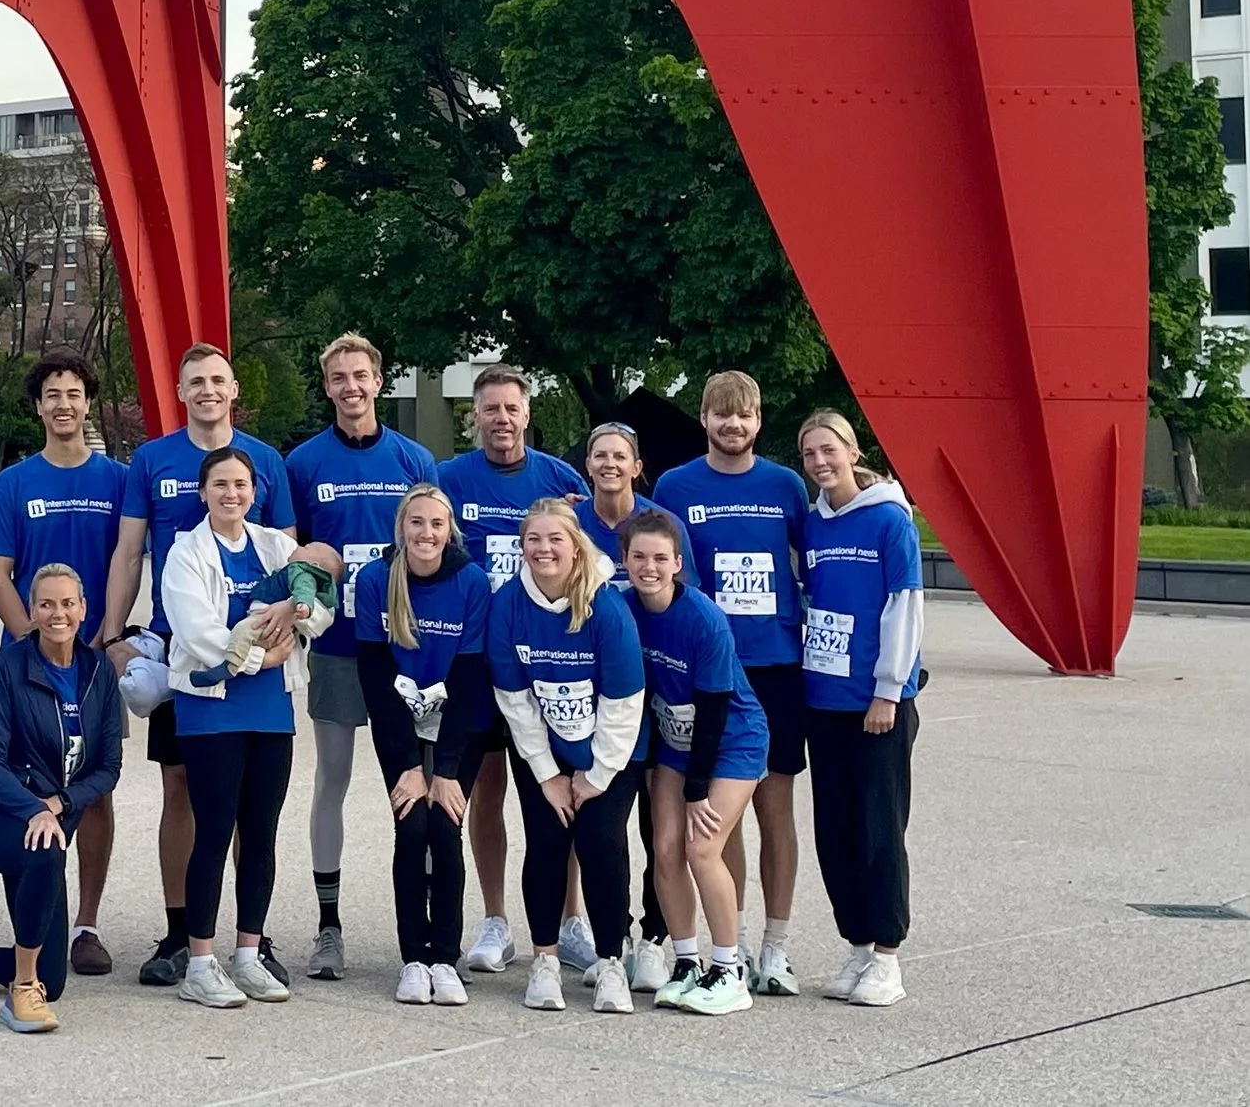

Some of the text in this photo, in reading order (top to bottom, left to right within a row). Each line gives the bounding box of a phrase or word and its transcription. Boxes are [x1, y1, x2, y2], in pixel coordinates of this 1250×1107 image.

[334, 481, 383, 492] international
[385, 483, 408, 491] needs
[706, 504, 758, 514] international
[759, 506, 783, 514] needs
[722, 572, 770, 593] 20121
[443, 622, 463, 632] need
[806, 627, 850, 654] 25328
[540, 697, 593, 721] 25326
